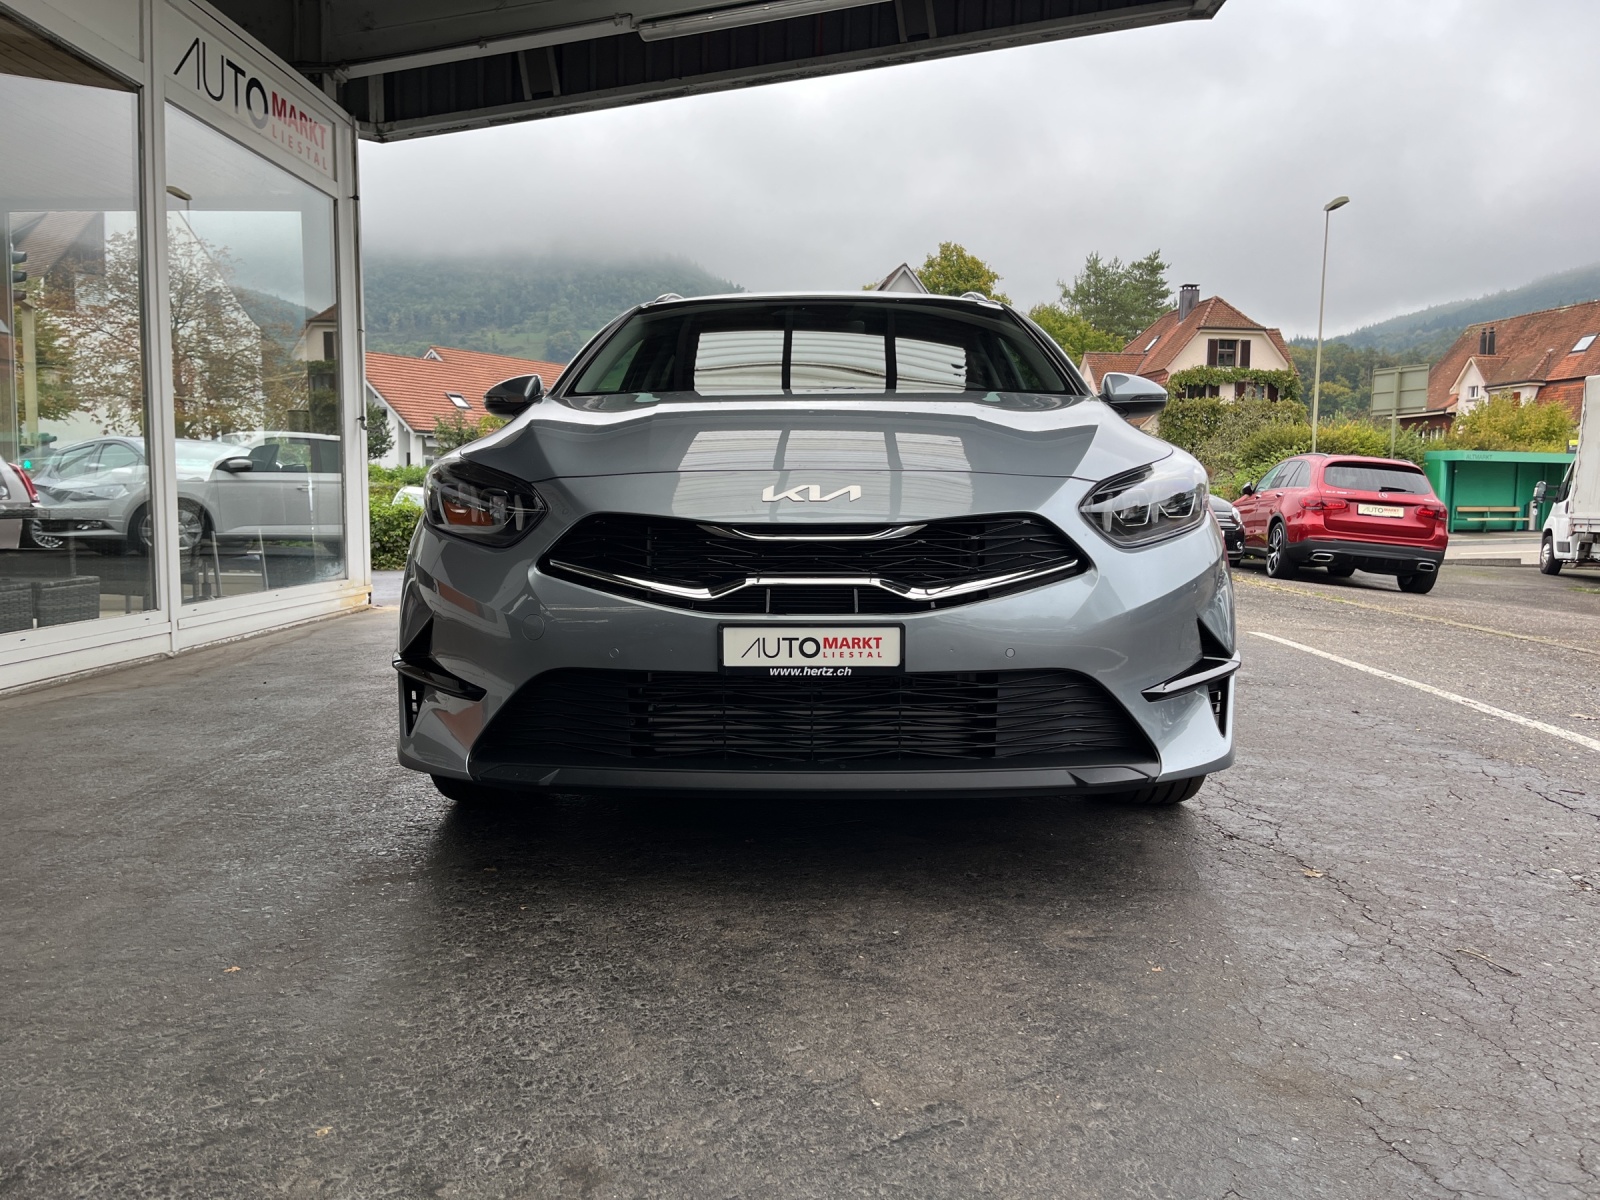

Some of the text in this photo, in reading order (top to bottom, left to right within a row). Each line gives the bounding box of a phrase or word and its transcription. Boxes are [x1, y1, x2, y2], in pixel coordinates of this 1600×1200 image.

[272, 91, 327, 150] MARKT
[272, 124, 328, 170] LIESTAL
[762, 484, 862, 502] KIA
[741, 637, 882, 658] AUTO MARKT
[769, 666, 852, 676] www.hertz.ch
